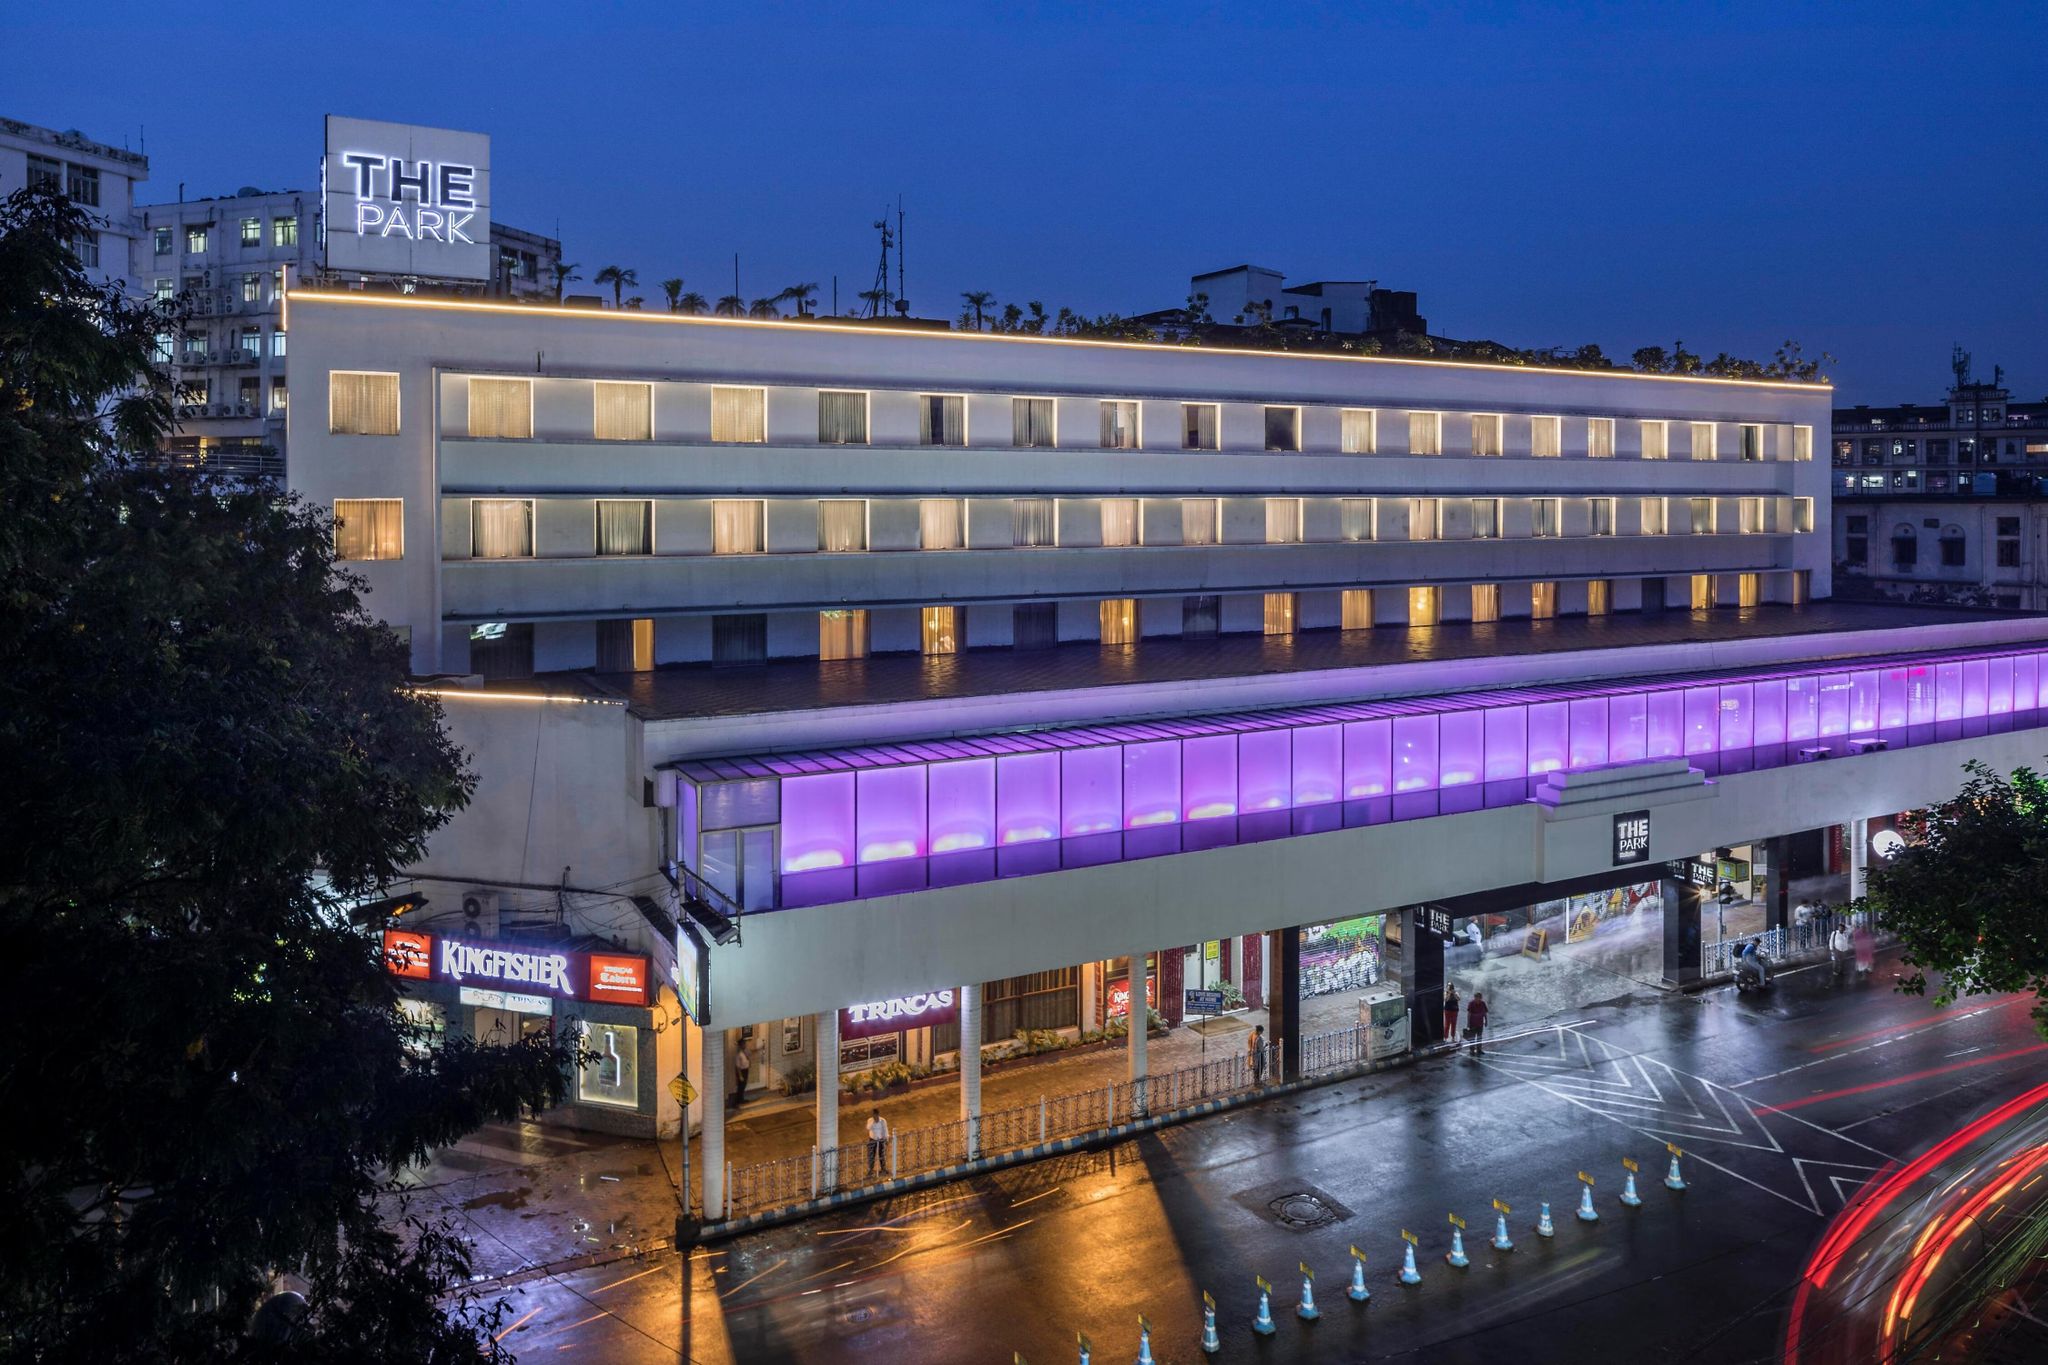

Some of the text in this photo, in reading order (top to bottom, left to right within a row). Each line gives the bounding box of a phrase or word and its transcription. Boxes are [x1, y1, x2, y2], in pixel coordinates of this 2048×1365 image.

[343, 152, 476, 211] THE
[357, 203, 475, 244] PARK
[1617, 819, 1649, 840] THE
[1620, 836, 1648, 851] PARK
[1691, 863, 1714, 877] THE
[1692, 873, 1713, 884] PARK
[1429, 909, 1450, 925] THE
[441, 940, 575, 995] KINGFISHER
[848, 990, 953, 1023] TRINCAS
